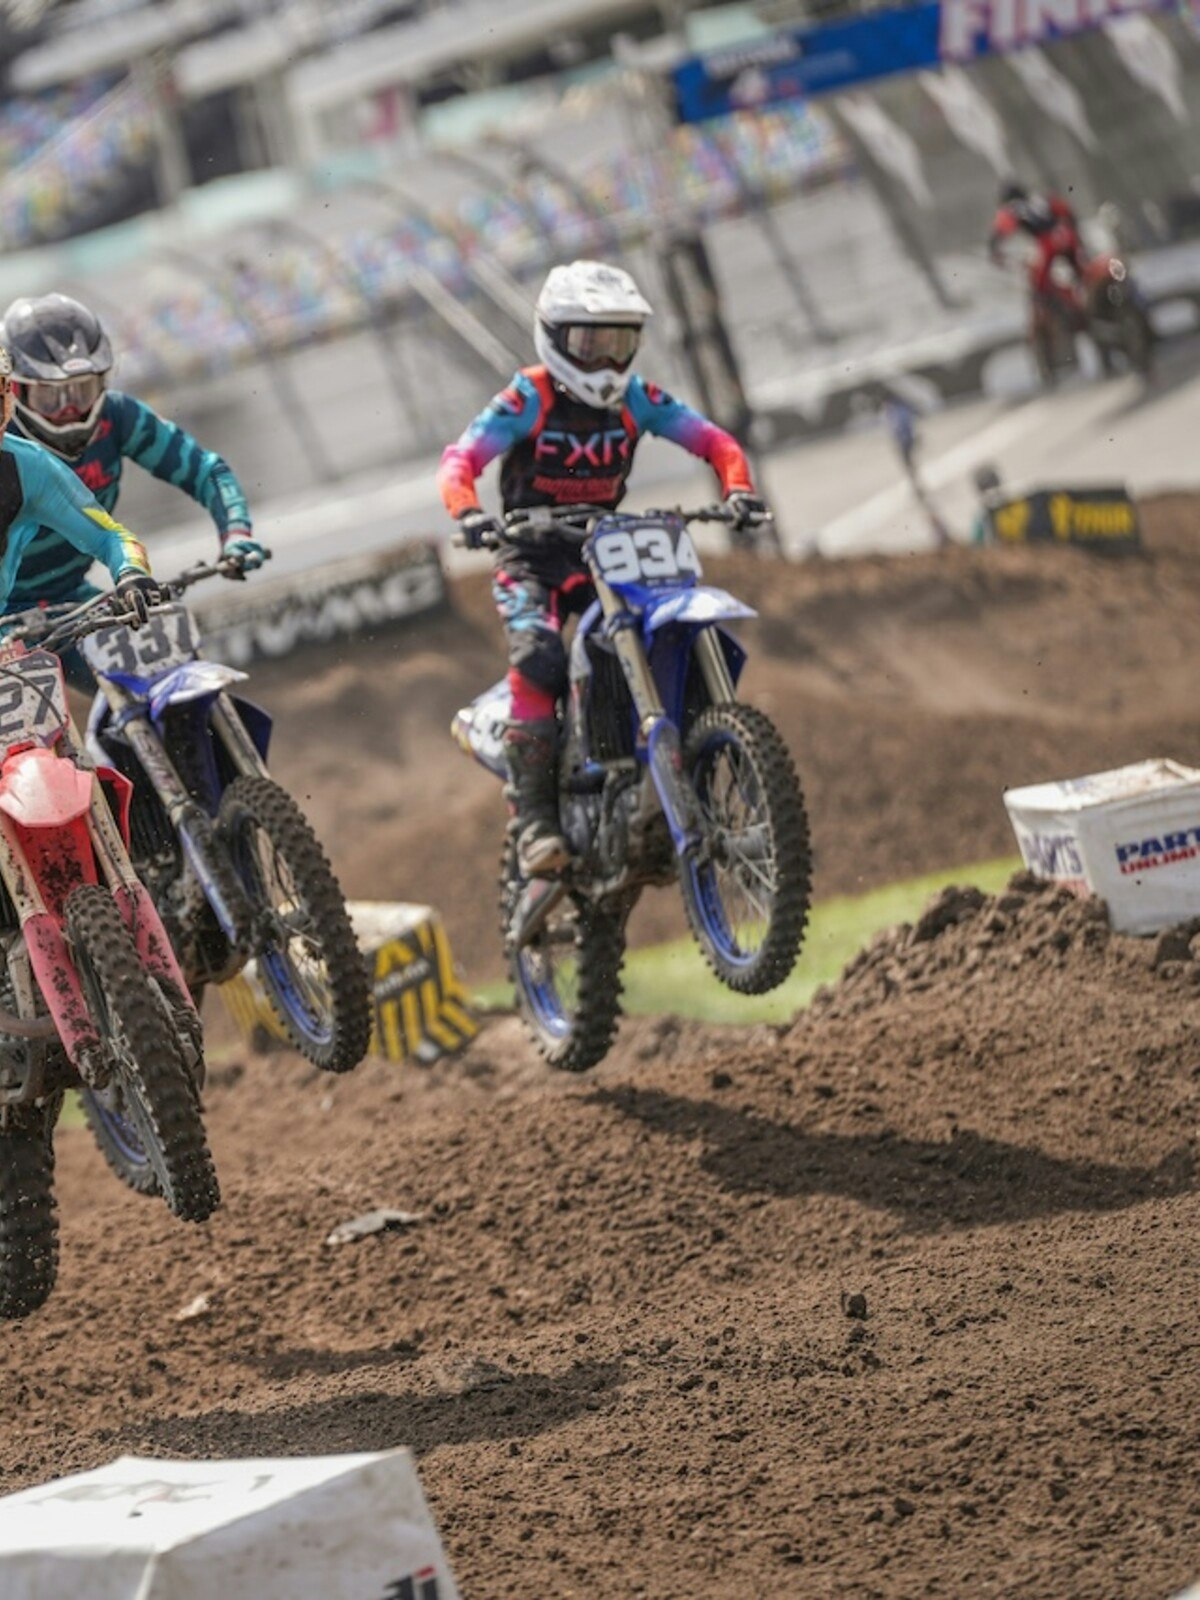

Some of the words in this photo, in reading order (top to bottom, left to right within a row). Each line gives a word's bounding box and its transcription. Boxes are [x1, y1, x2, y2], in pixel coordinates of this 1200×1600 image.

[534, 429, 629, 467] FXR
[595, 528, 703, 583] 934
[95, 605, 192, 674] 337
[1115, 826, 1200, 863] PART
[1120, 845, 1200, 874] UNLIMI
